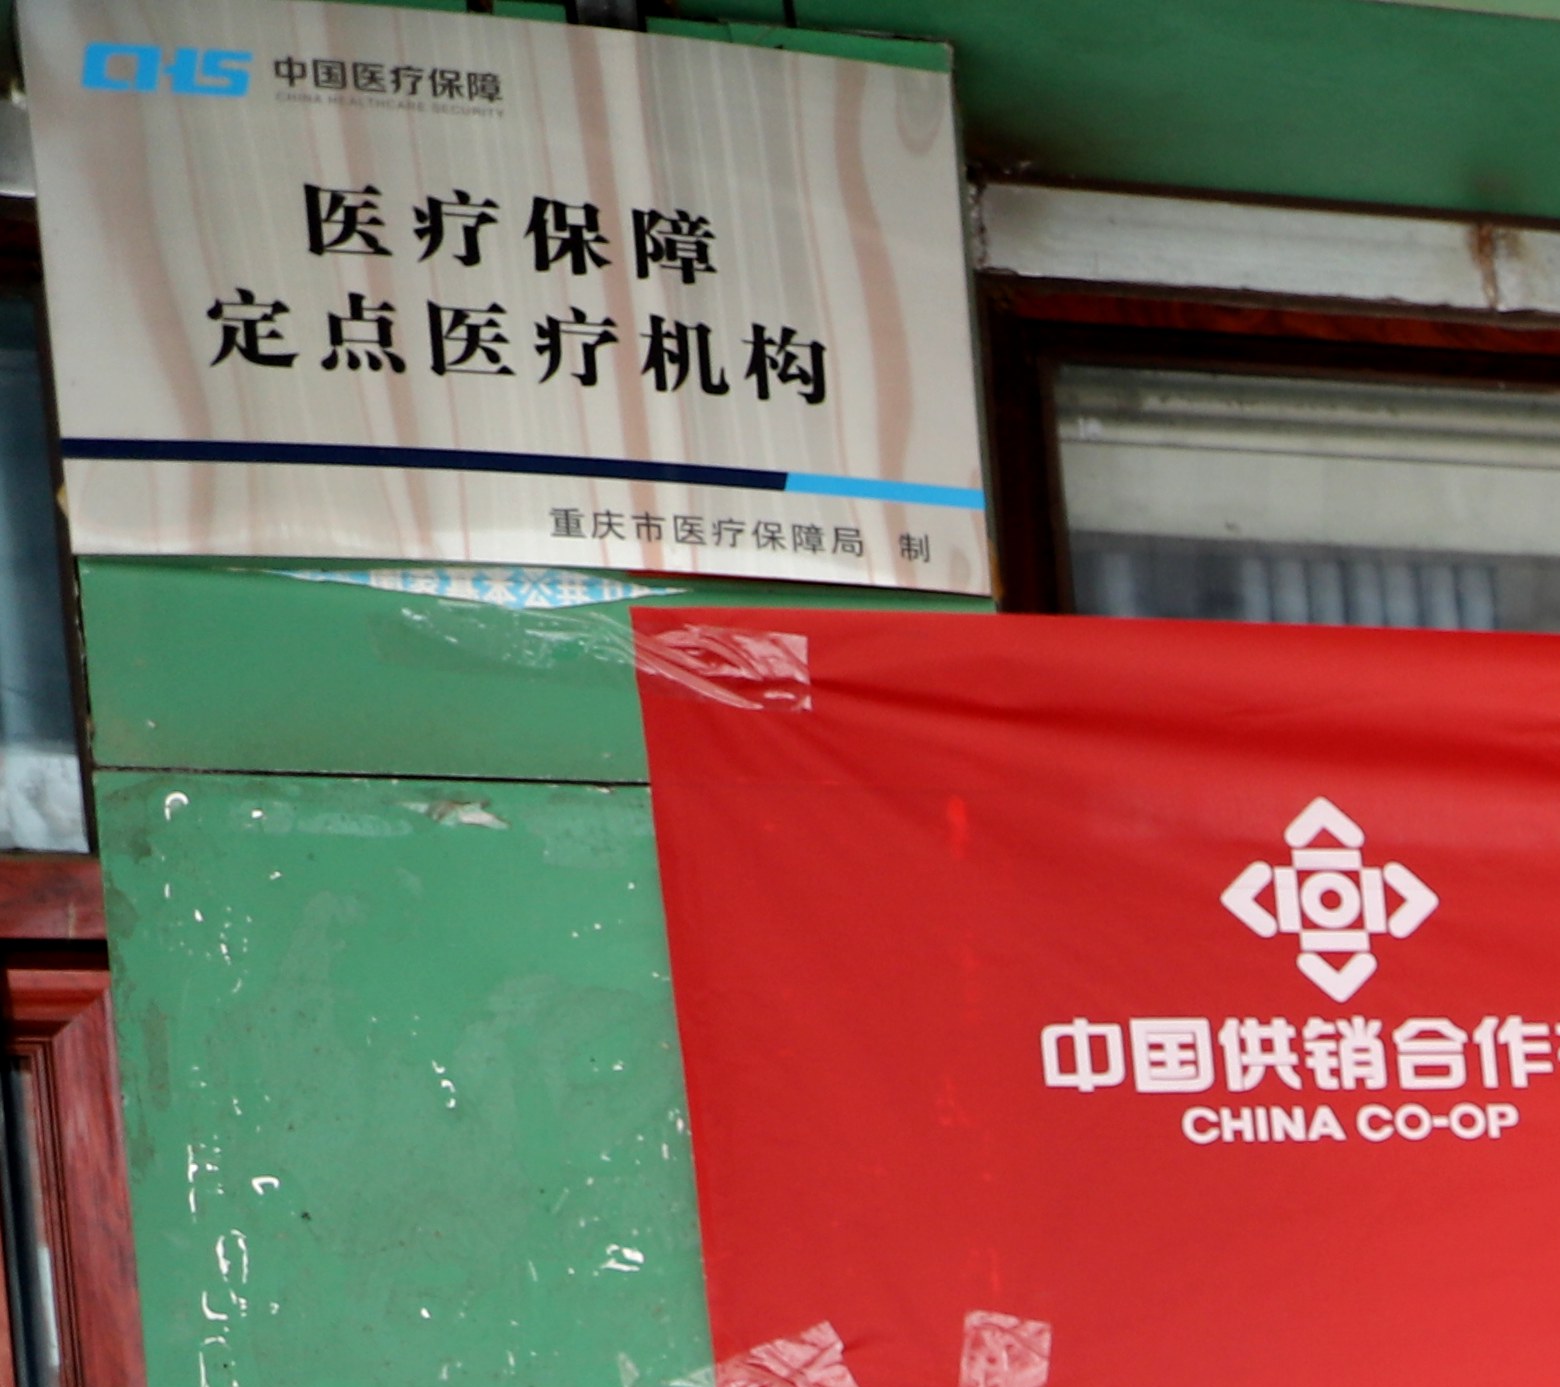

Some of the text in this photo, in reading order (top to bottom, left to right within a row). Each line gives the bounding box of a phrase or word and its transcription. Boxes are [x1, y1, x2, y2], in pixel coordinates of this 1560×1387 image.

[81, 42, 254, 98] CHS
[272, 55, 504, 104] 中国医疗保障
[304, 181, 718, 287] 医疗保障
[206, 286, 828, 406] 定点医疗机构
[549, 507, 932, 563] 重庆市医疗保障局 制
[1182, 1102, 1520, 1144] CHINA CO-OP
